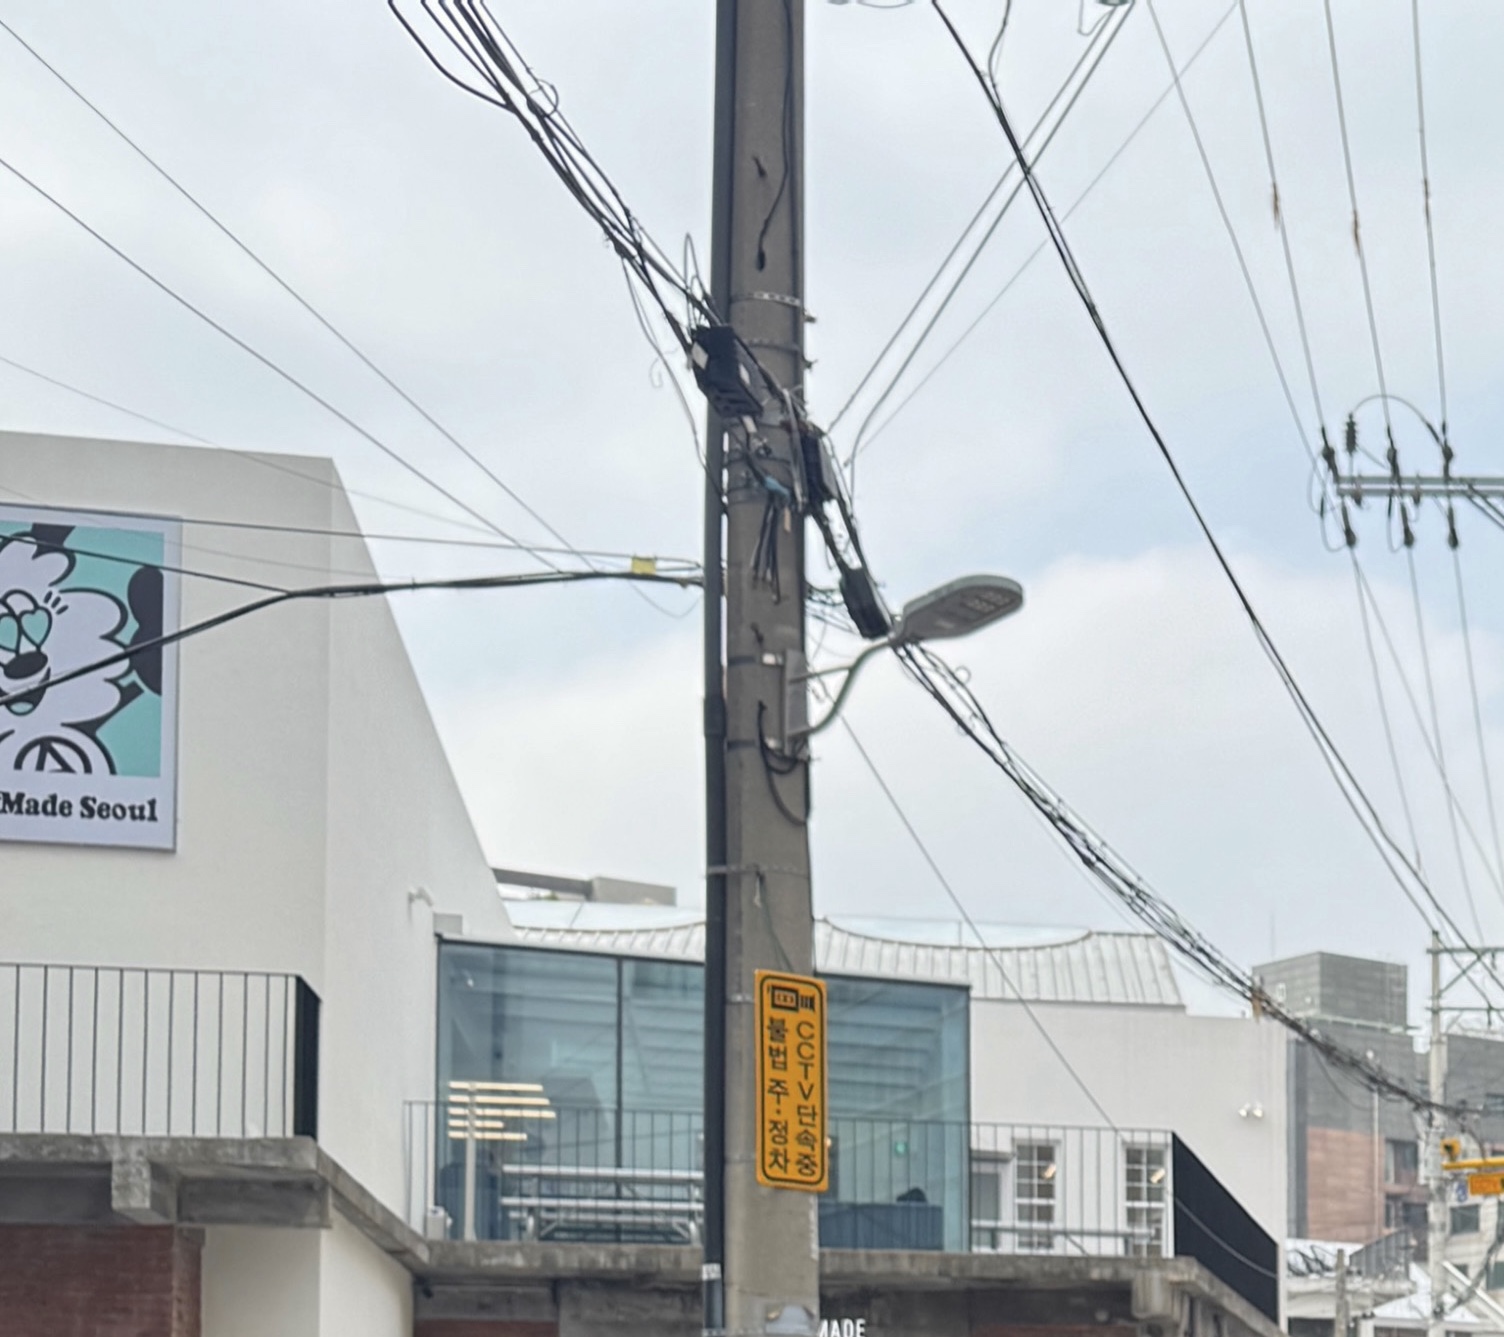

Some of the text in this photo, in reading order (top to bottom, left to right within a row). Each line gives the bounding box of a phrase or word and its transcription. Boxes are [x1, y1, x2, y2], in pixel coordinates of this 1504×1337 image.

[0, 791, 158, 822] Made Seoul
[767, 1016, 788, 1071] 불법
